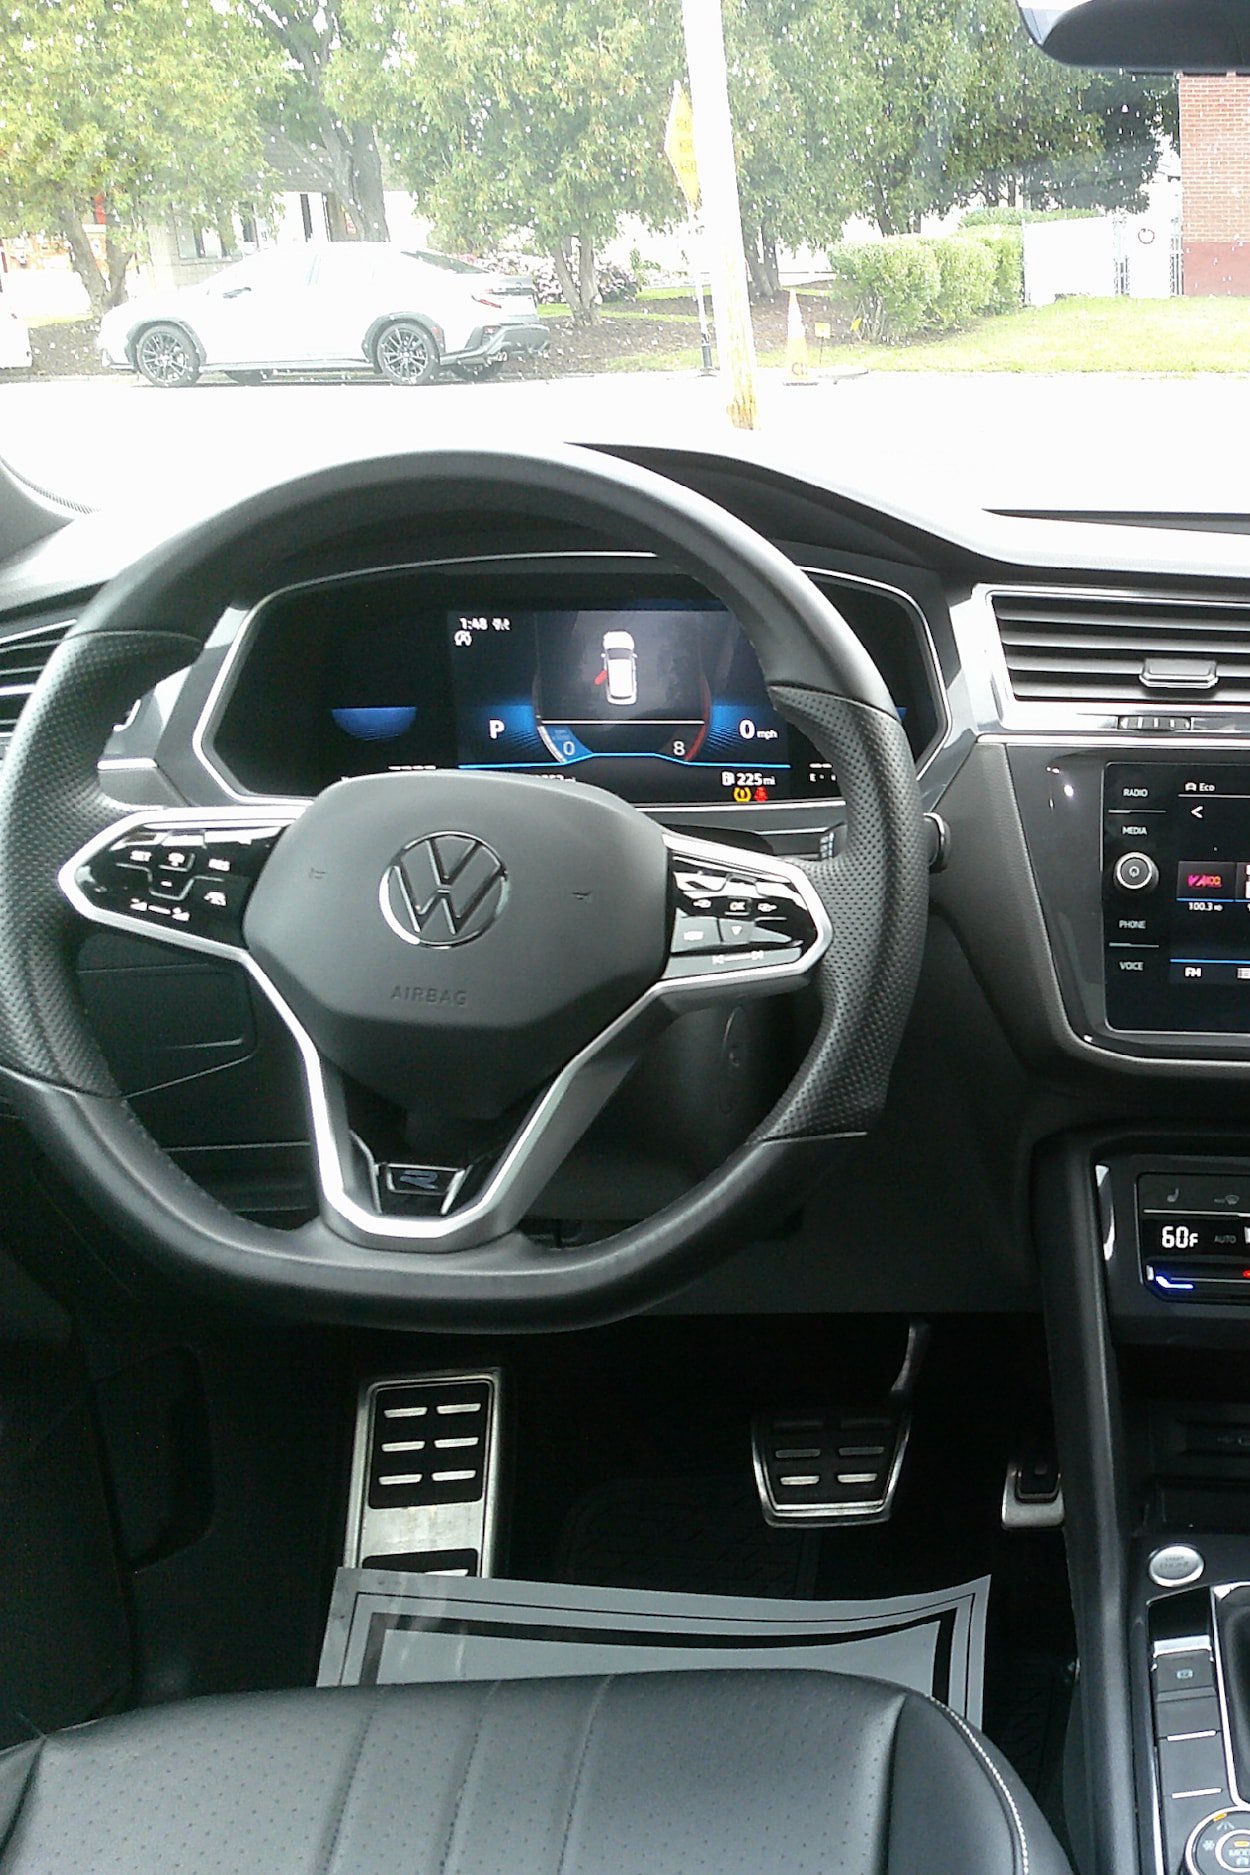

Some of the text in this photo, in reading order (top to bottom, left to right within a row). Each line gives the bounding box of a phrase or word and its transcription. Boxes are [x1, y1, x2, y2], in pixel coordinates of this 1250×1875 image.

[460, 617, 488, 630] 1:48
[489, 719, 505, 739] P
[739, 719, 778, 740] 0 mph
[563, 741, 575, 756] 0
[673, 741, 686, 756] 8
[1199, 783, 1215, 791] Eco
[1123, 788, 1148, 797] RADIO
[1122, 826, 1147, 835] MEDIA
[729, 901, 746, 911] OK
[1188, 902, 1213, 911] 100.3
[1119, 920, 1146, 929] PHONE
[1119, 962, 1144, 971] VOICE
[1185, 967, 1202, 977] FM
[391, 985, 468, 1006] AIRBAG
[1214, 1235, 1237, 1244] AUTO
